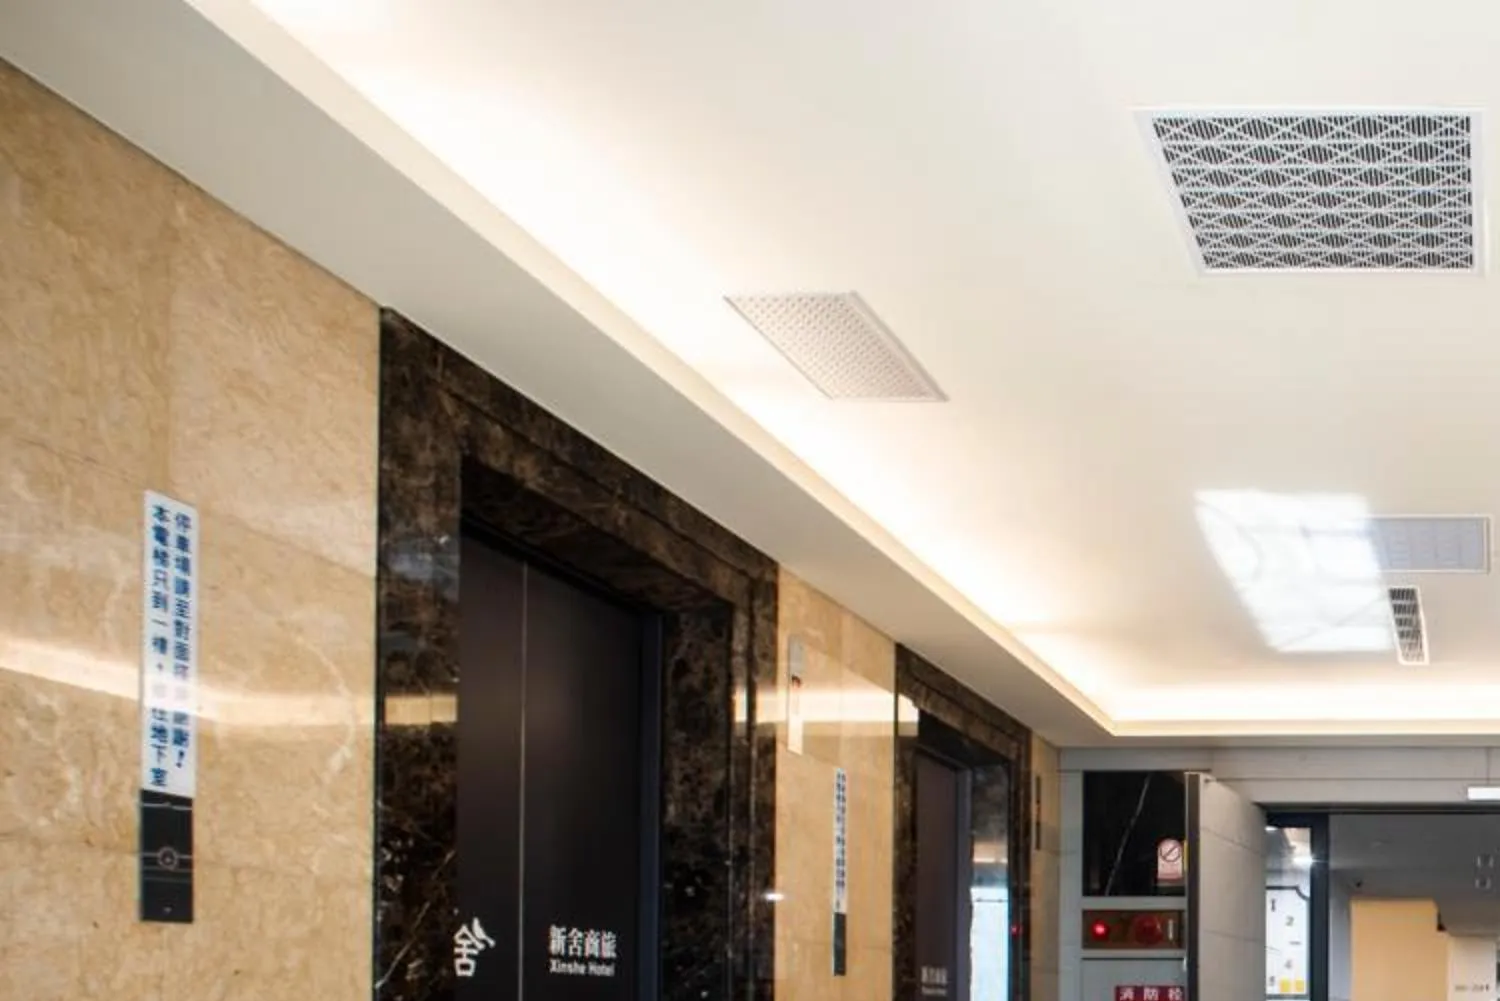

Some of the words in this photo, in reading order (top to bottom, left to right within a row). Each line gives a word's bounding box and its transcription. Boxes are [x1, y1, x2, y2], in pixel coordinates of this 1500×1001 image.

[453, 917, 495, 977] 舍
[549, 925, 616, 958] 新舍商旅
